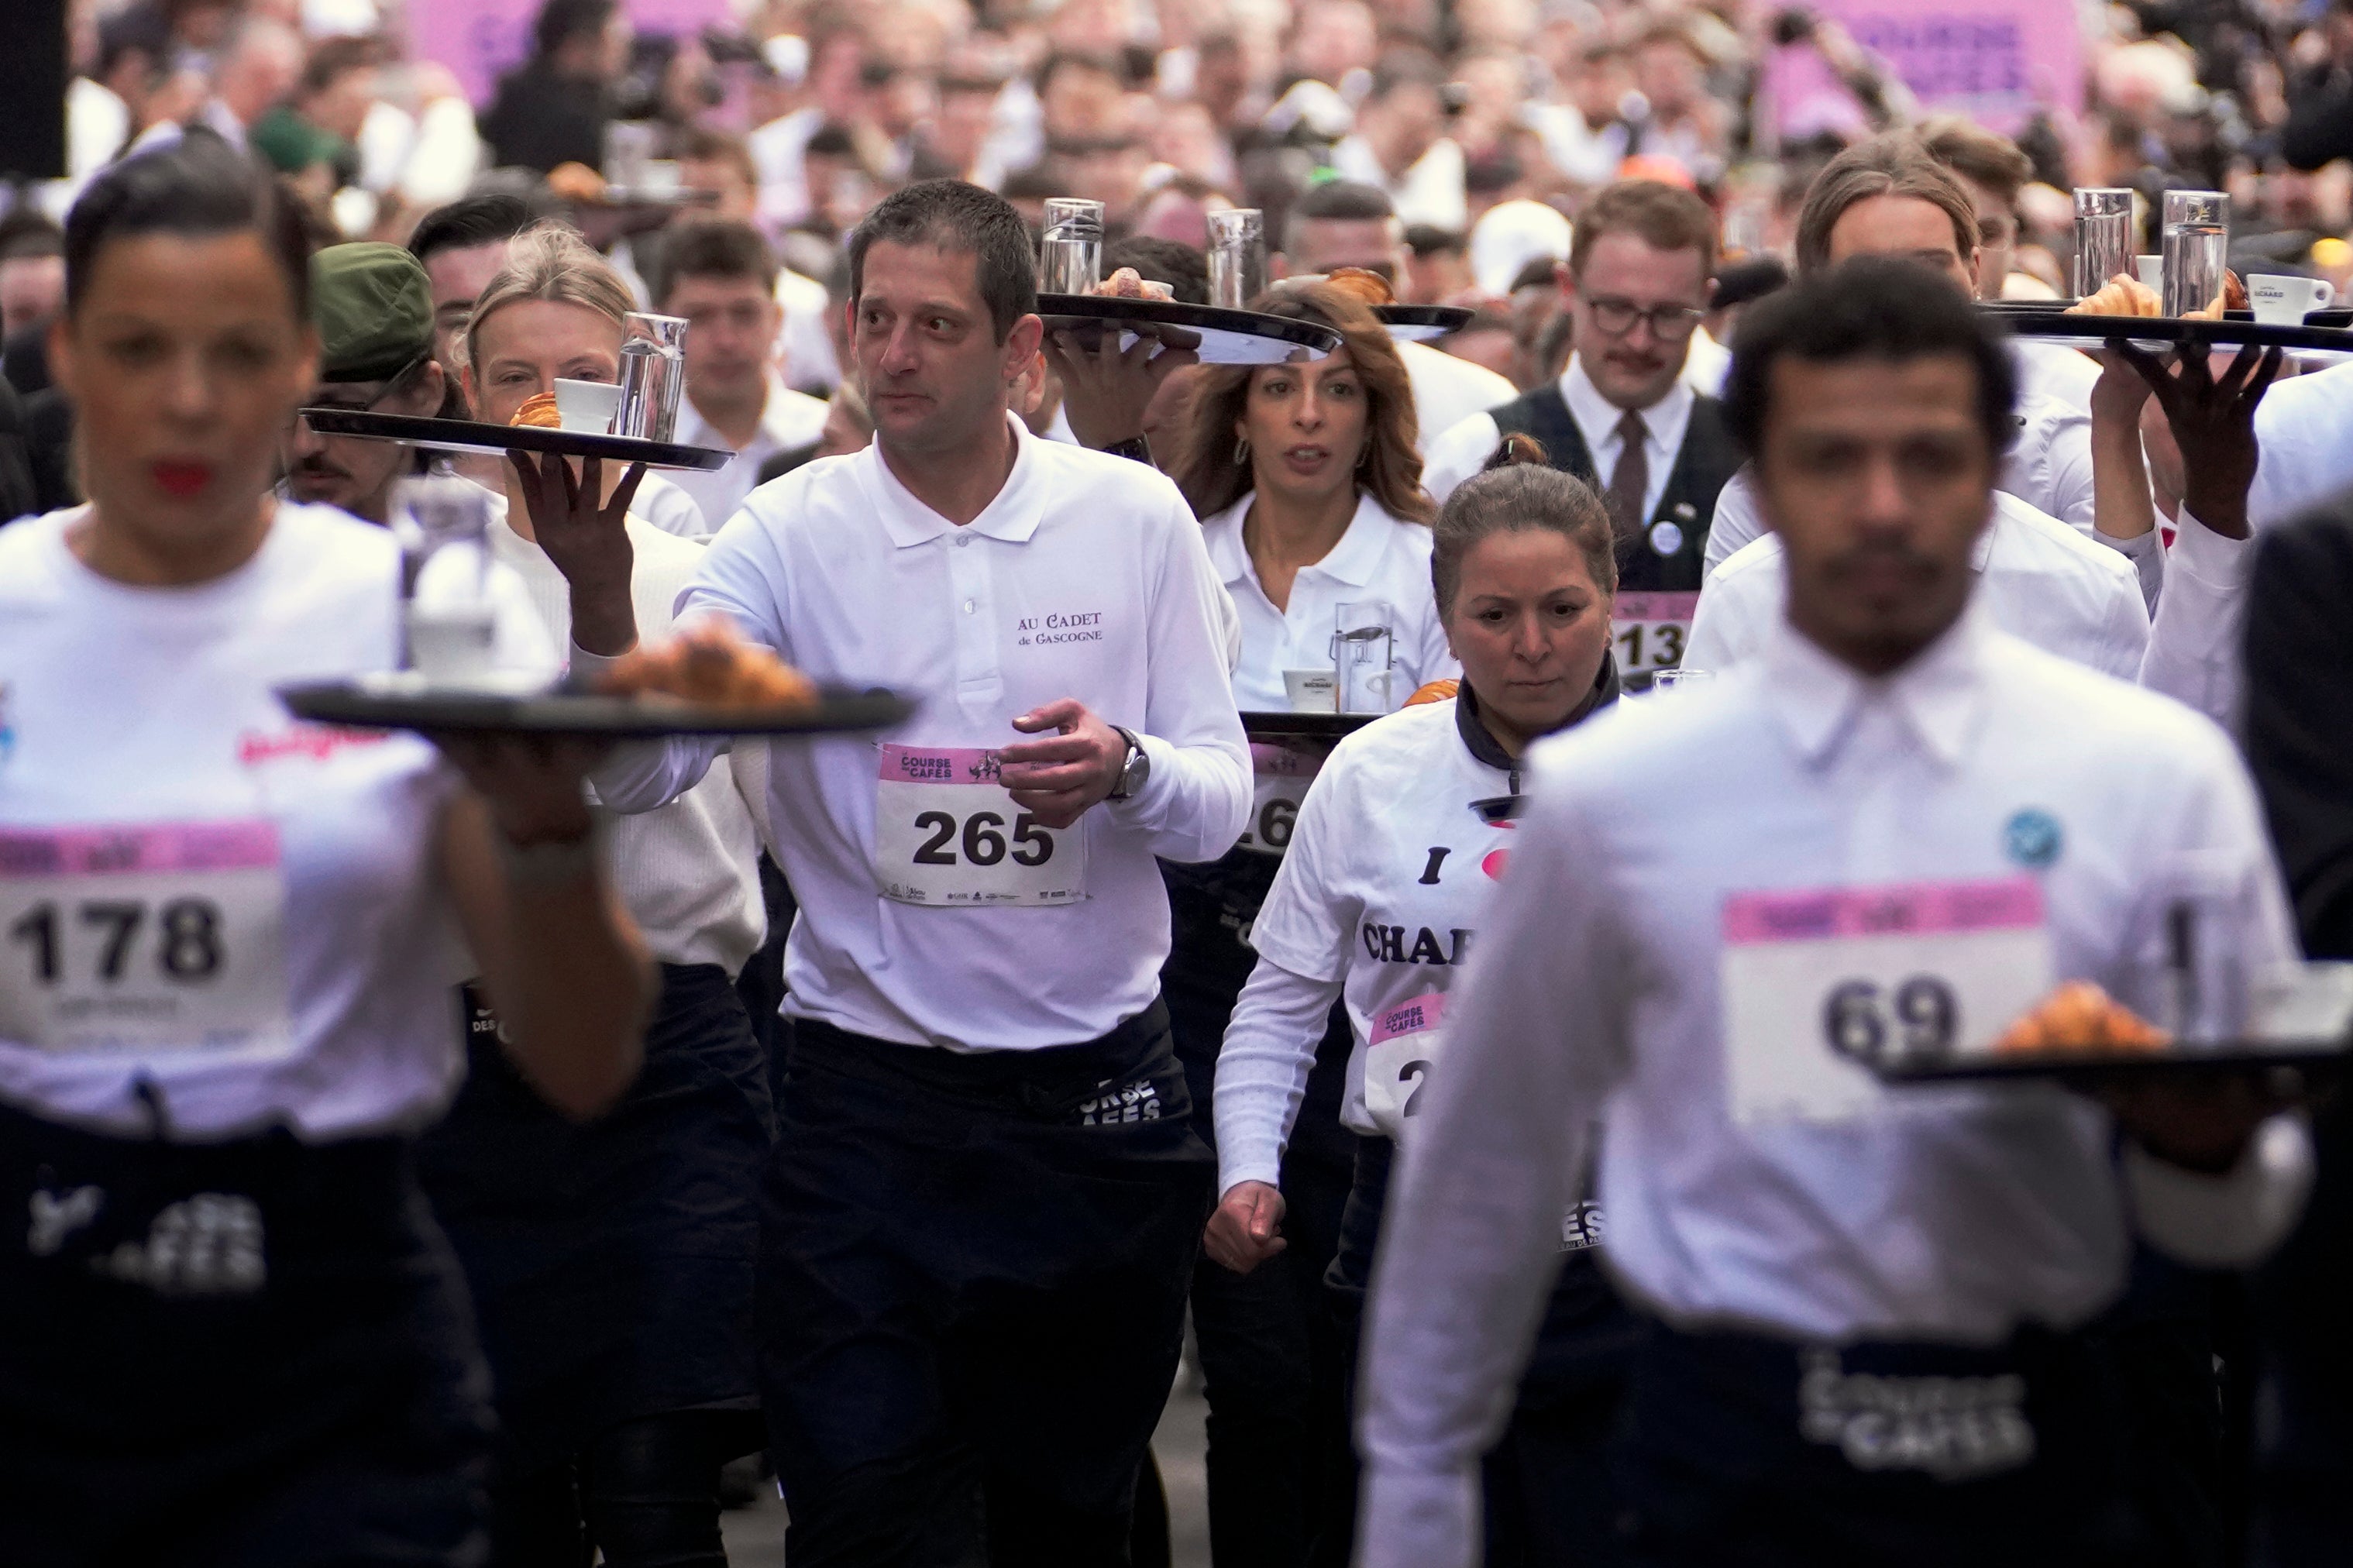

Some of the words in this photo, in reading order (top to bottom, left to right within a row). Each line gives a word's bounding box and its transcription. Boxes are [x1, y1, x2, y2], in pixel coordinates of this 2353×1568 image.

[1018, 618, 1038, 631] AU
[1046, 612, 1102, 629] CADET
[1018, 637, 1030, 645] de
[1036, 631, 1103, 645] GASCOGNE
[901, 756, 951, 769] COURSE
[913, 810, 1054, 866] 265
[1418, 846, 1451, 885] I
[9, 897, 226, 986] 178
[1386, 1006, 1423, 1024] COURSE
[1821, 976, 1959, 1065] 69
[473, 1020, 497, 1033] DES
